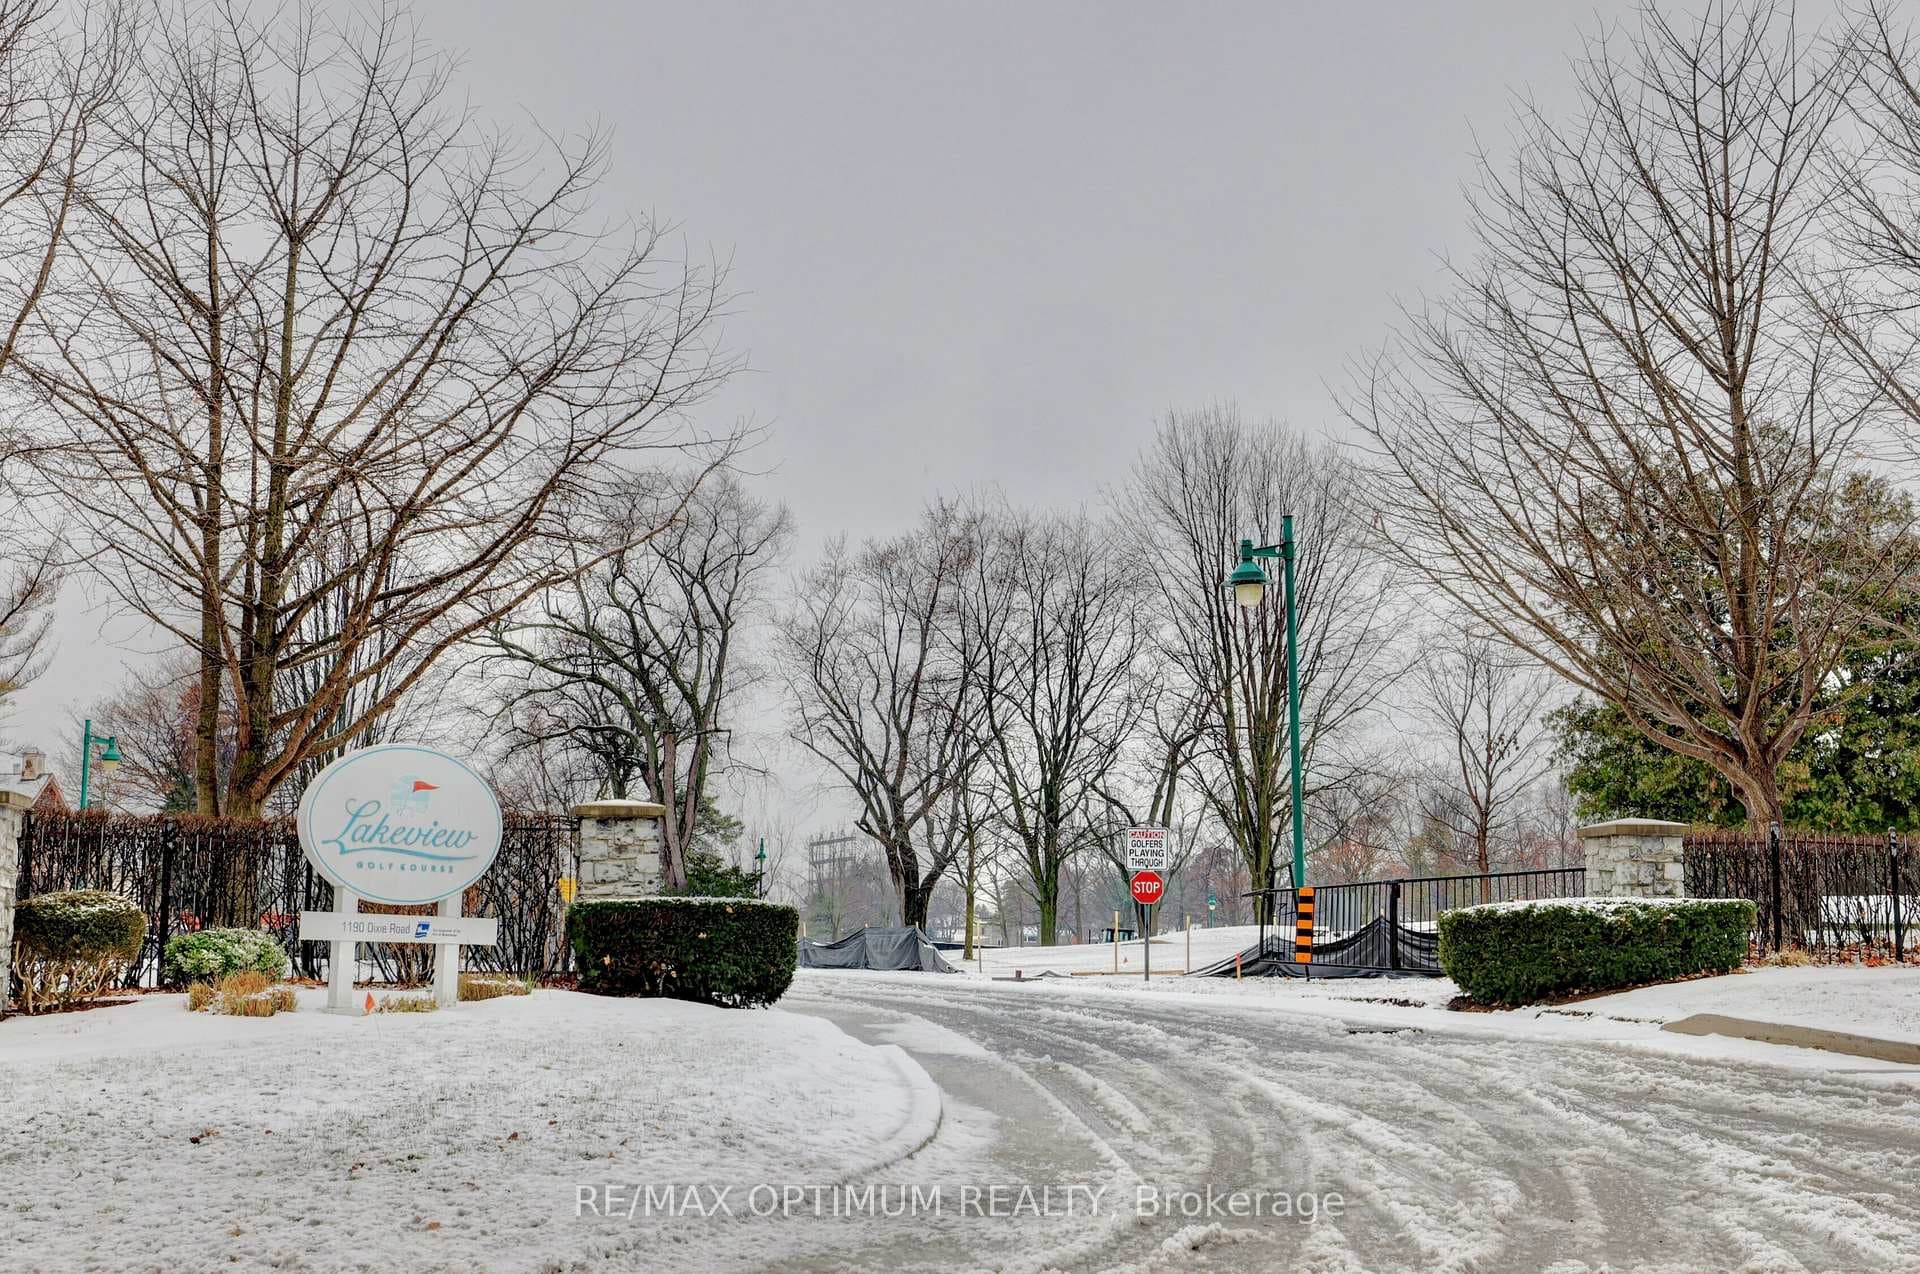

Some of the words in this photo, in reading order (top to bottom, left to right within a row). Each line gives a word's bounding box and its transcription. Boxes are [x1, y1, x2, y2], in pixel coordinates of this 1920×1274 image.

[321, 798, 479, 861] Lakeview
[1131, 840, 1163, 848] GOLFERS
[1129, 849, 1164, 857] PLAYING
[356, 861, 394, 871] GOLF
[400, 863, 455, 874] COURSE
[1131, 858, 1163, 867] THROUGH
[1134, 881, 1160, 893] STOP
[342, 921, 365, 933] 1190
[367, 922, 387, 934] Dixie
[389, 923, 411, 934] Road
